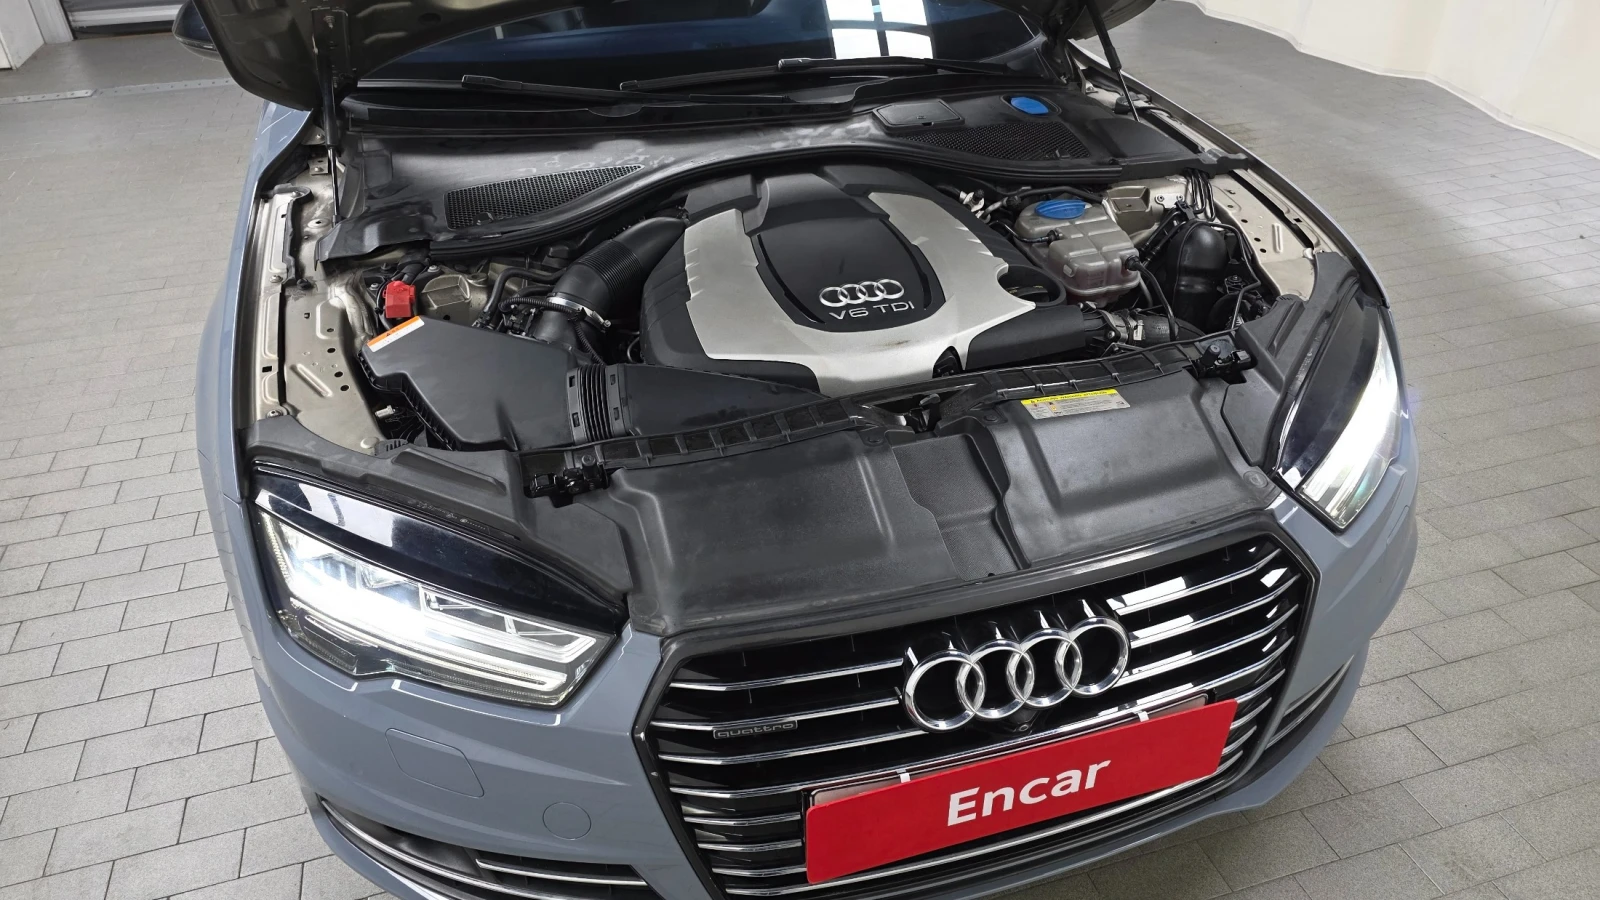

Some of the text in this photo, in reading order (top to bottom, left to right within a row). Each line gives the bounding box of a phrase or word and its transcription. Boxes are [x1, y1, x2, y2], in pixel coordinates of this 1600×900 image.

[829, 301, 915, 320] V6 TDI
[717, 723, 794, 738] quattro
[947, 760, 1112, 827] Encar
